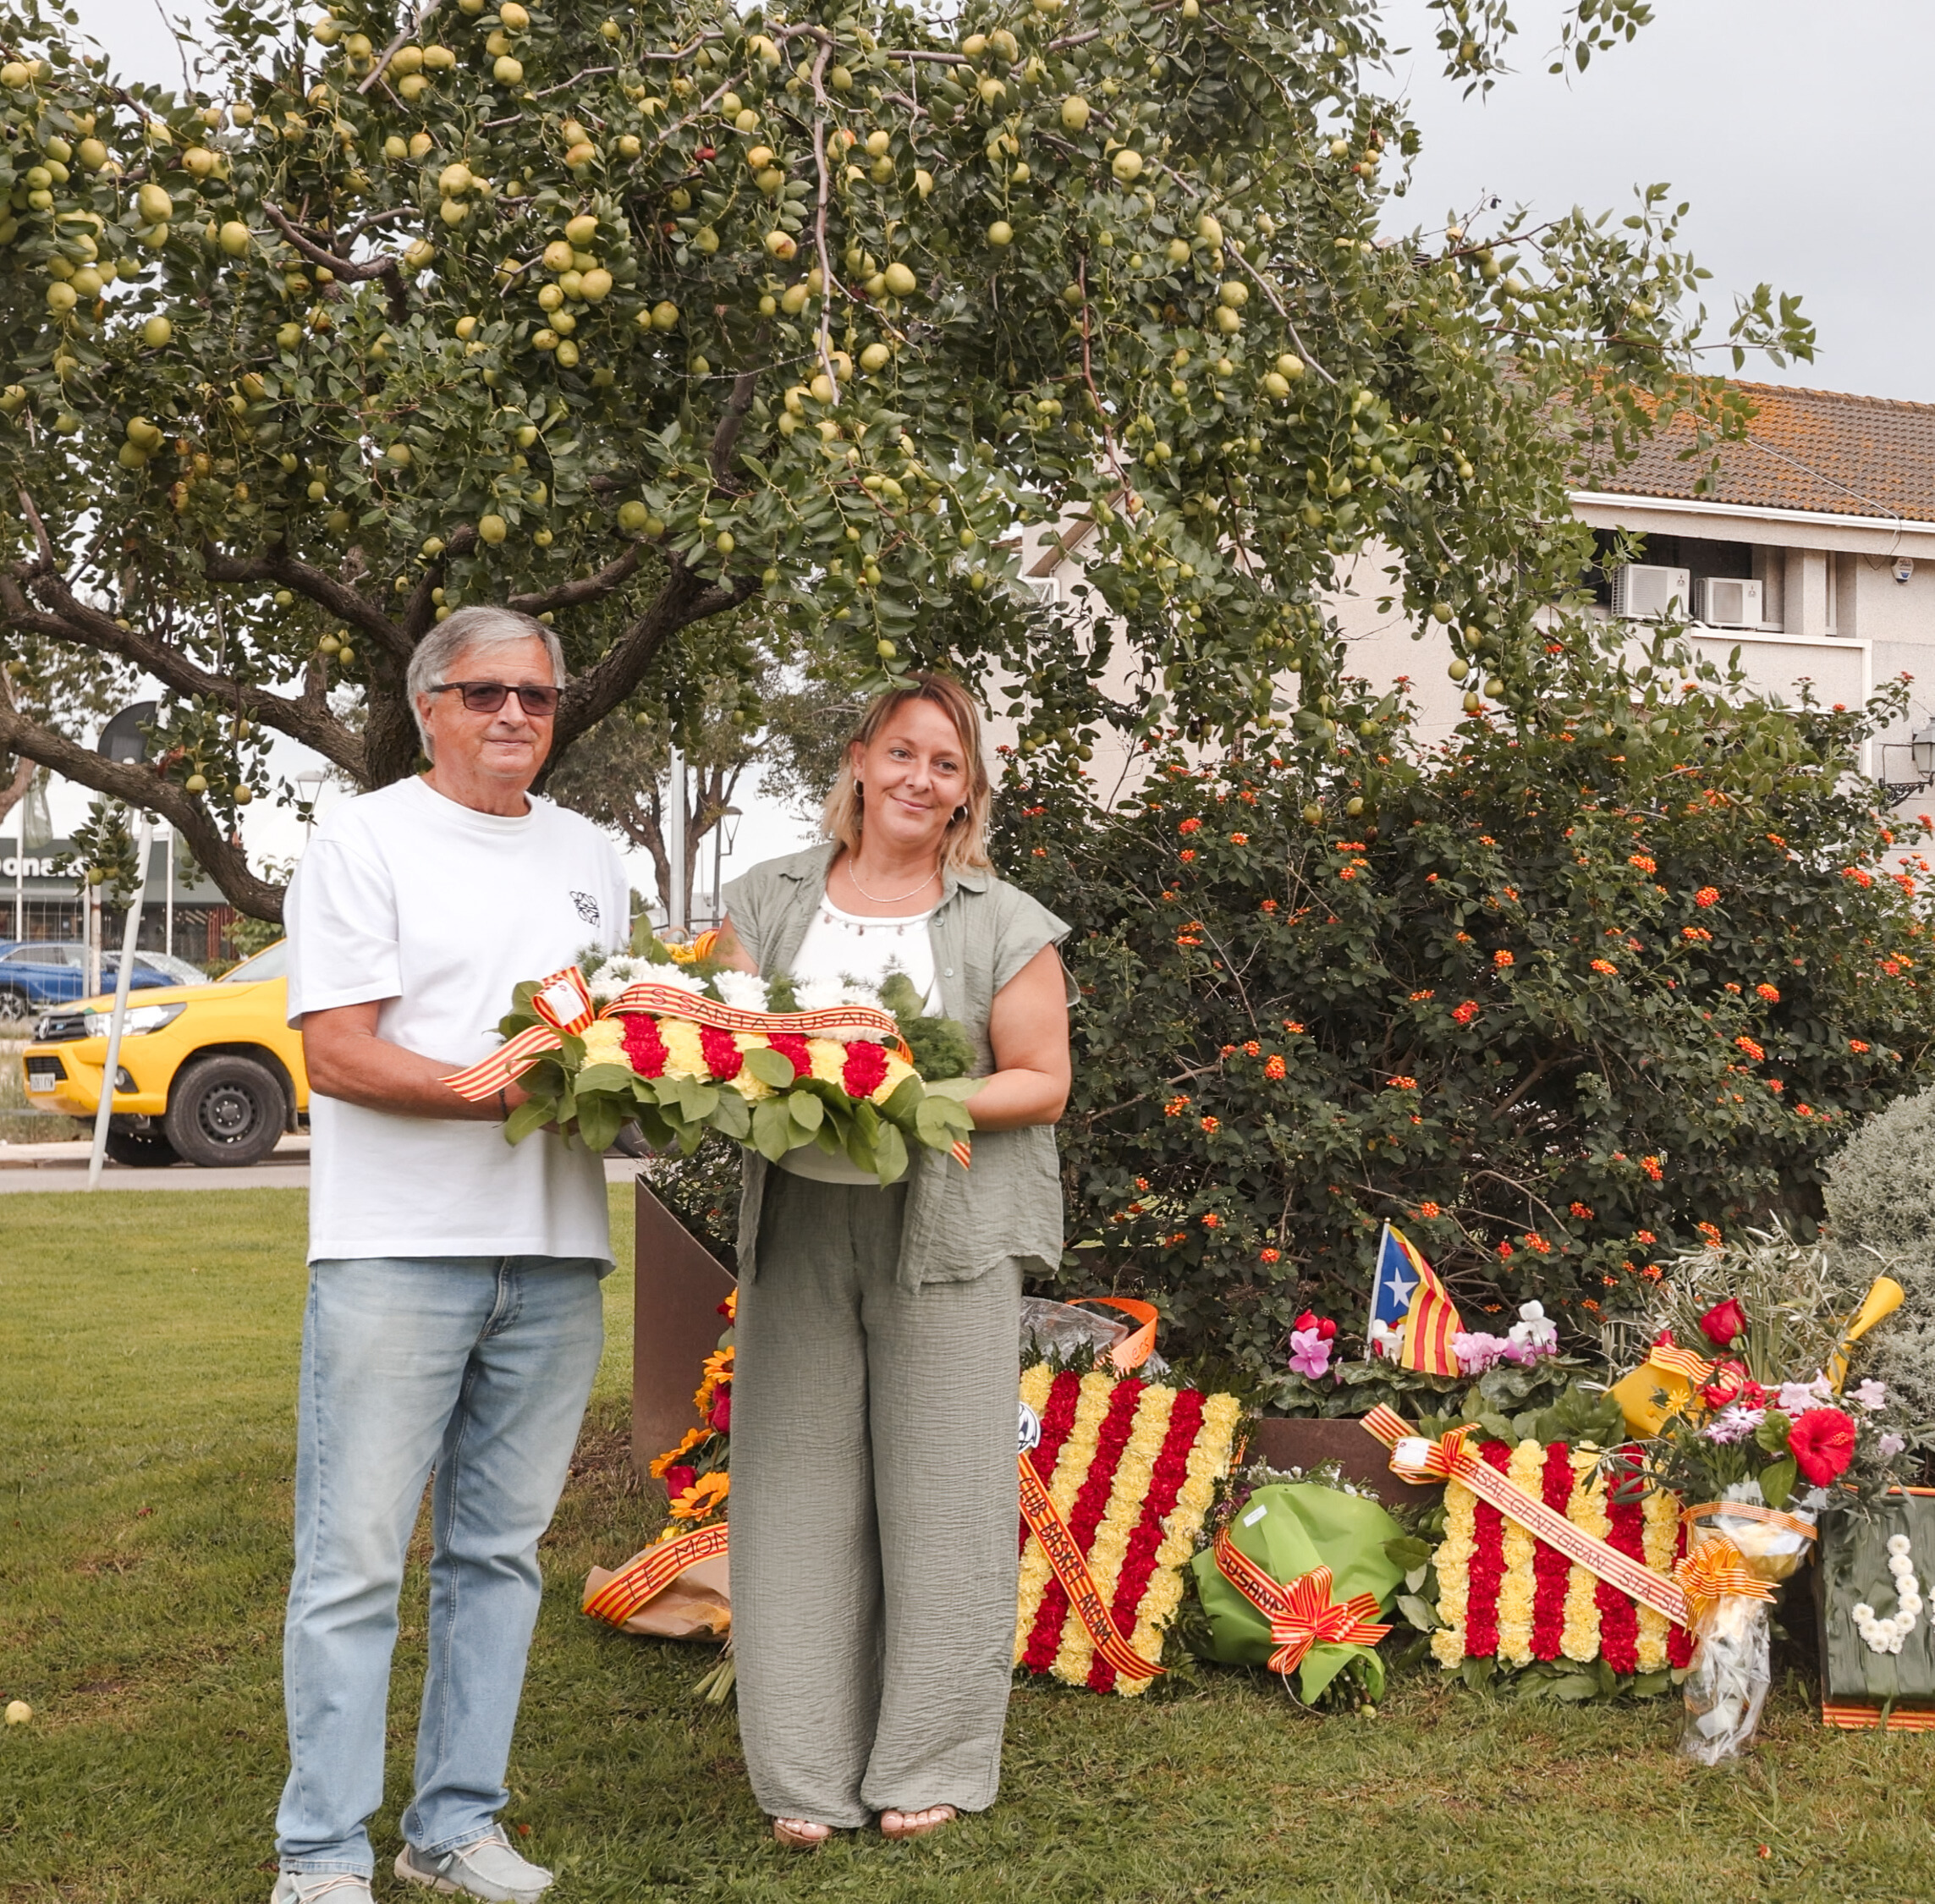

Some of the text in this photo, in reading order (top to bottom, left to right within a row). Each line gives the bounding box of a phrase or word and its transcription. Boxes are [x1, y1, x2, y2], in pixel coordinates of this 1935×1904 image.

[678, 995, 769, 1030] SANTA
[1019, 1478, 1047, 1517] CLUB
[1039, 1521, 1086, 1585] BASKET
[1458, 1456, 1506, 1504] CASAL
[1509, 1498, 1557, 1535] GENT
[1556, 1533, 1607, 1571] GRAN
[1218, 1544, 1292, 1614] SUSANN
